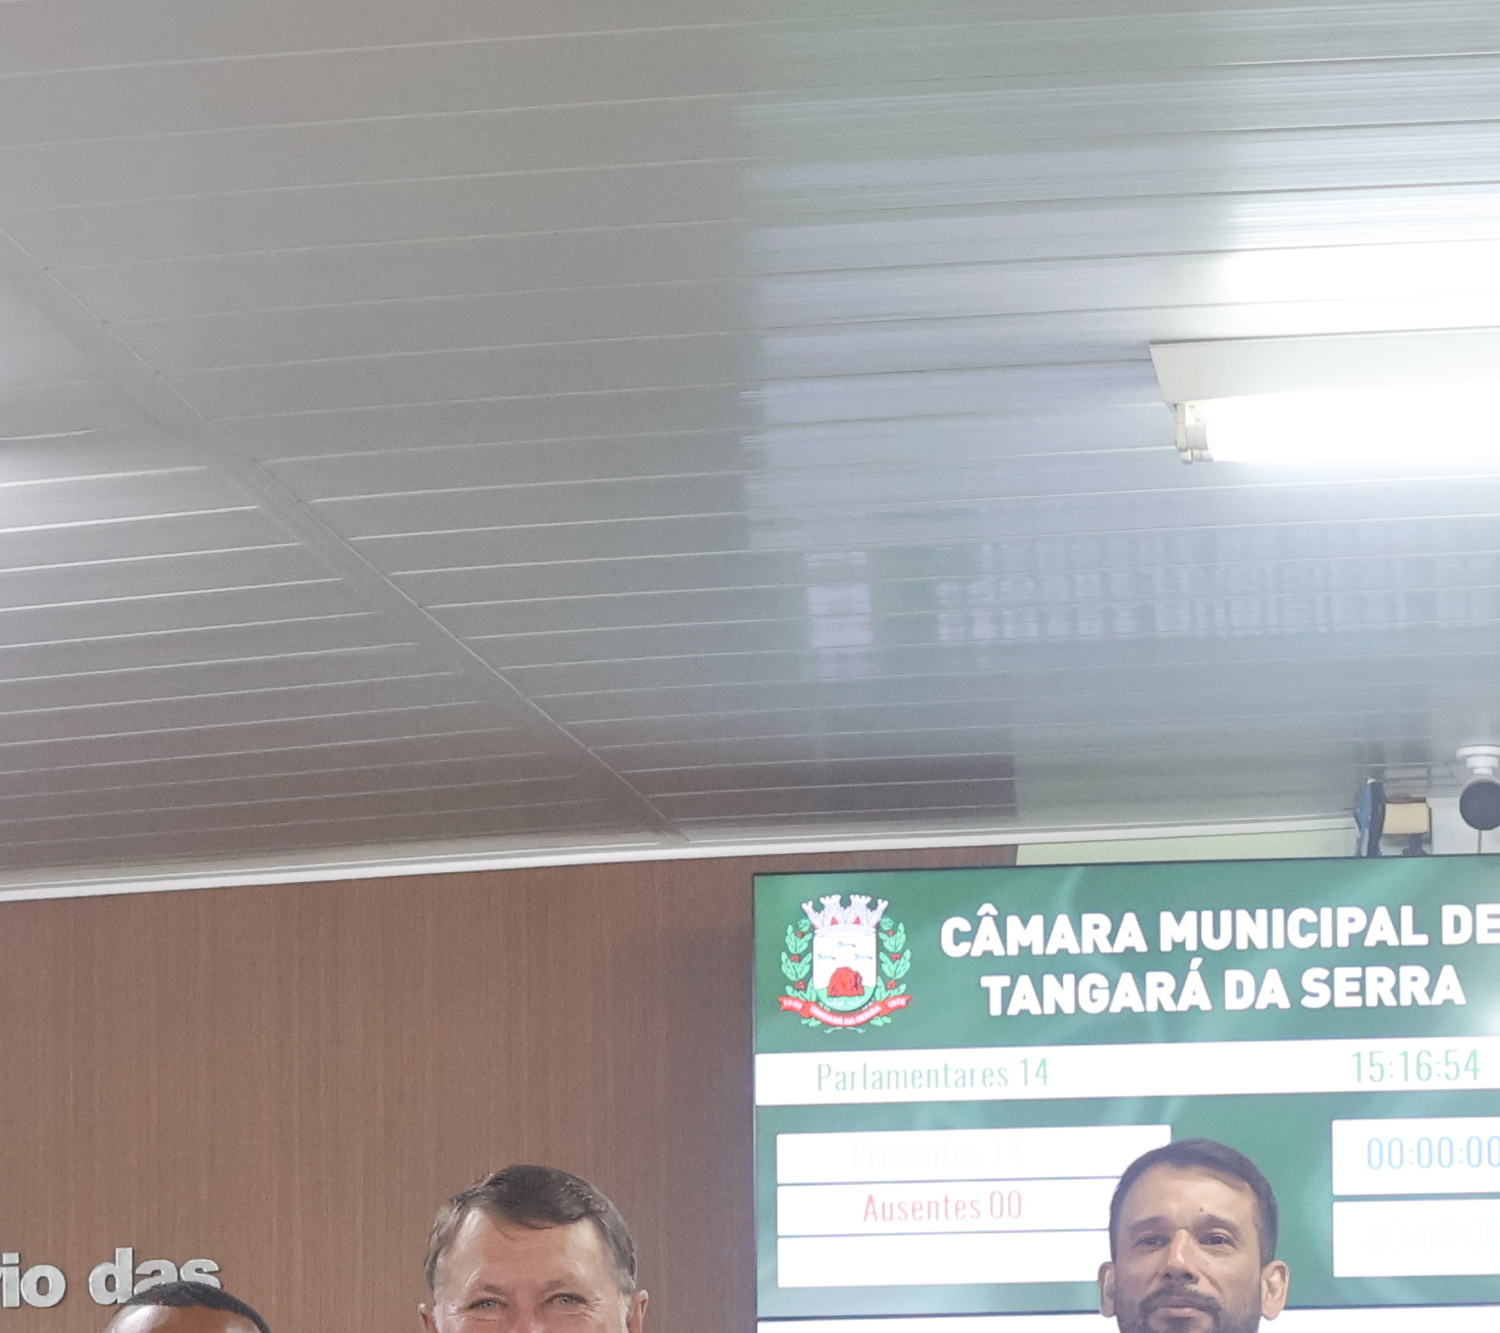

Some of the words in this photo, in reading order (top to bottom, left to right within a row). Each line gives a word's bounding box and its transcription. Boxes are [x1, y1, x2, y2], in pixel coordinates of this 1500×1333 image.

[940, 904, 1148, 958] CÂMARA
[1159, 906, 1427, 952] MUNICIPAL
[980, 958, 1211, 1016] TANGARÁ
[1223, 968, 1290, 1011] DA
[1302, 964, 1466, 1007] SERRA
[817, 1062, 1009, 1091] Parlamentares
[1019, 1058, 1049, 1087] 14
[1351, 1050, 1481, 1083] 15:16:54
[863, 1193, 982, 1222] Ausentes
[990, 1190, 1023, 1219] 00
